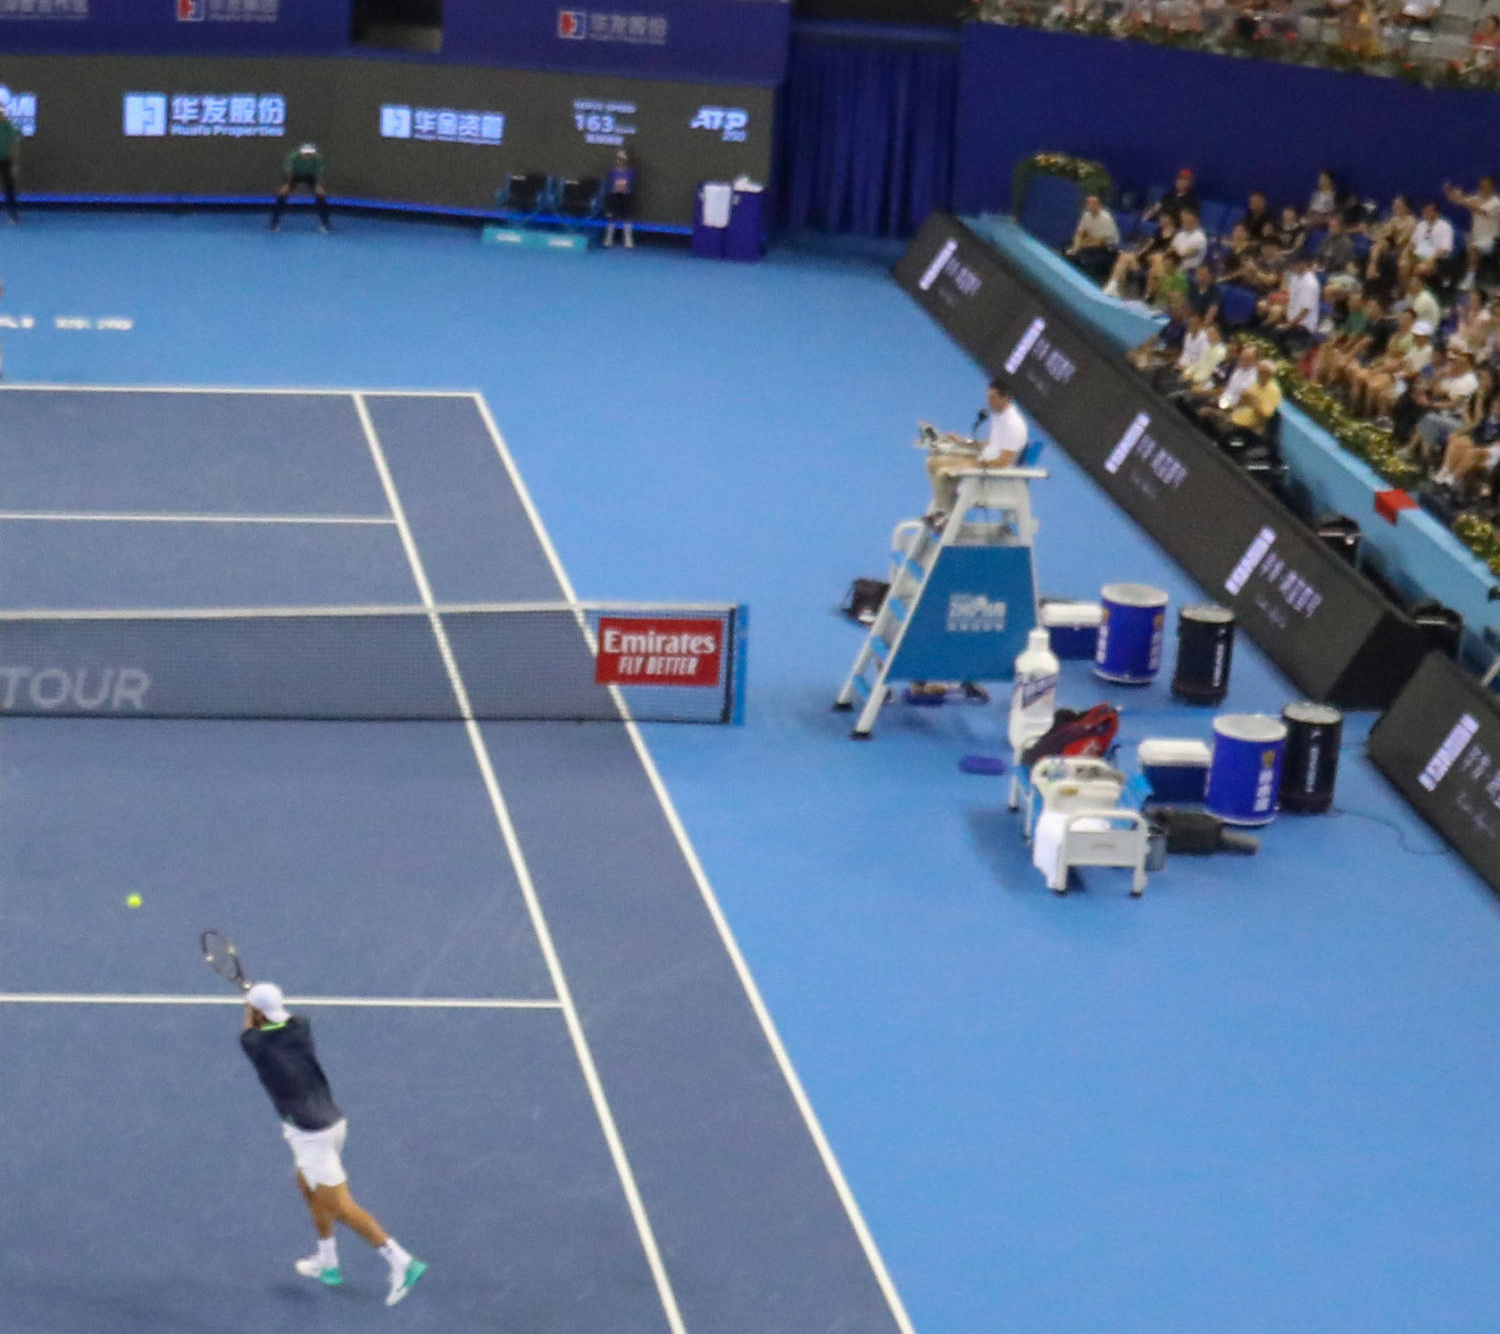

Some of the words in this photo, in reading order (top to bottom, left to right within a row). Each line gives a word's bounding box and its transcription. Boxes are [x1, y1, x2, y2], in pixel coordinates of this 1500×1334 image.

[171, 94, 287, 124] 华发股份
[690, 107, 749, 130] ATP
[575, 114, 615, 133] 163
[604, 629, 717, 654] Emirates
[617, 656, 645, 675] FLY
[647, 656, 699, 676] BETTER
[0, 666, 150, 711] TOUR
